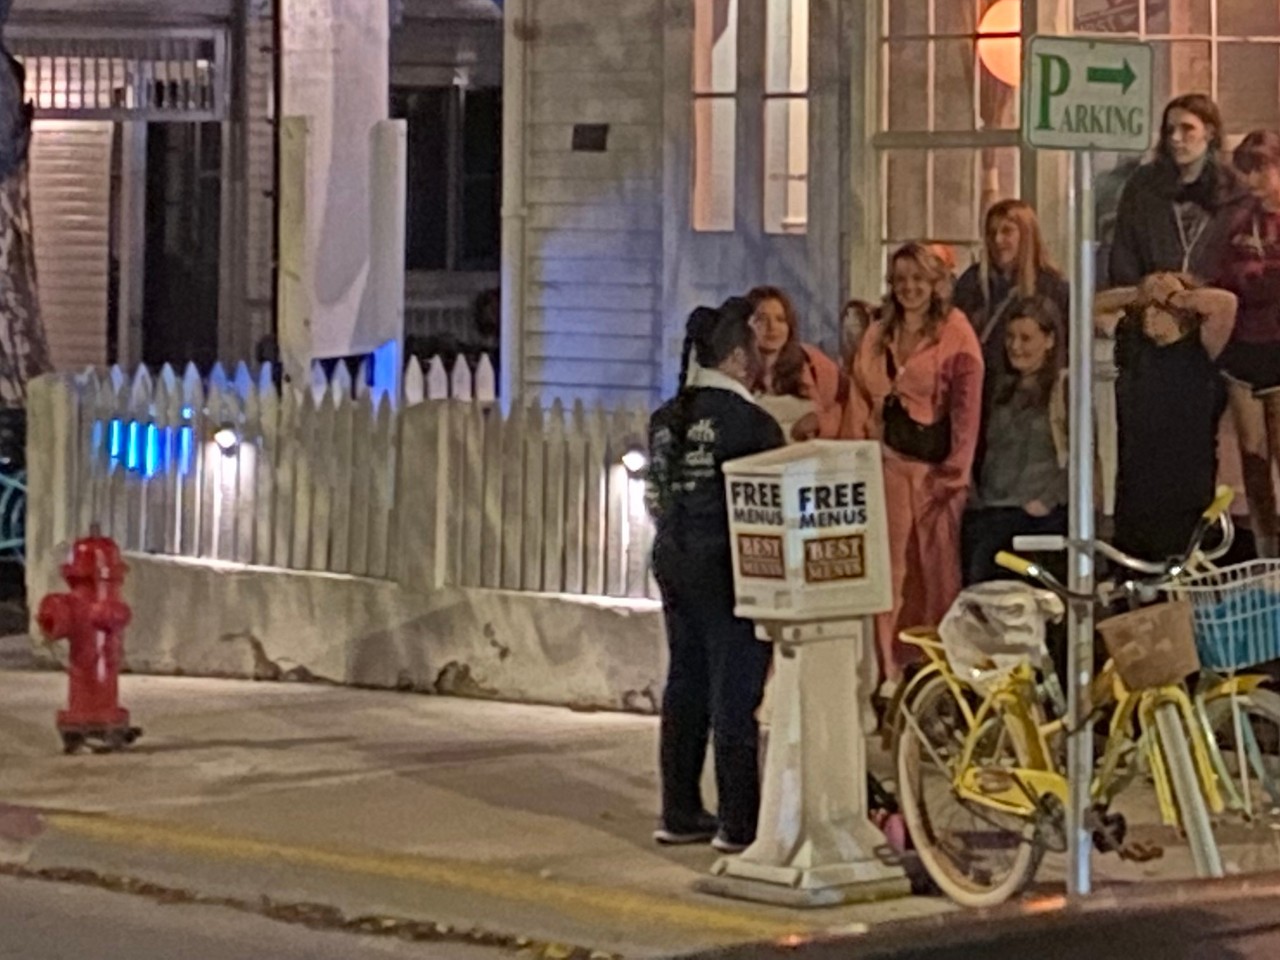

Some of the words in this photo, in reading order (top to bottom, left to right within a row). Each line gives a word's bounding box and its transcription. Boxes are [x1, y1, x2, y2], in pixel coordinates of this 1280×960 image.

[1034, 52, 1144, 136] PARKING
[730, 481, 782, 508] FREE
[798, 481, 866, 512] FREE
[733, 507, 784, 527] MENUS
[799, 508, 868, 530] MENUS
[741, 537, 781, 558] BEST
[808, 537, 861, 561] BEST
